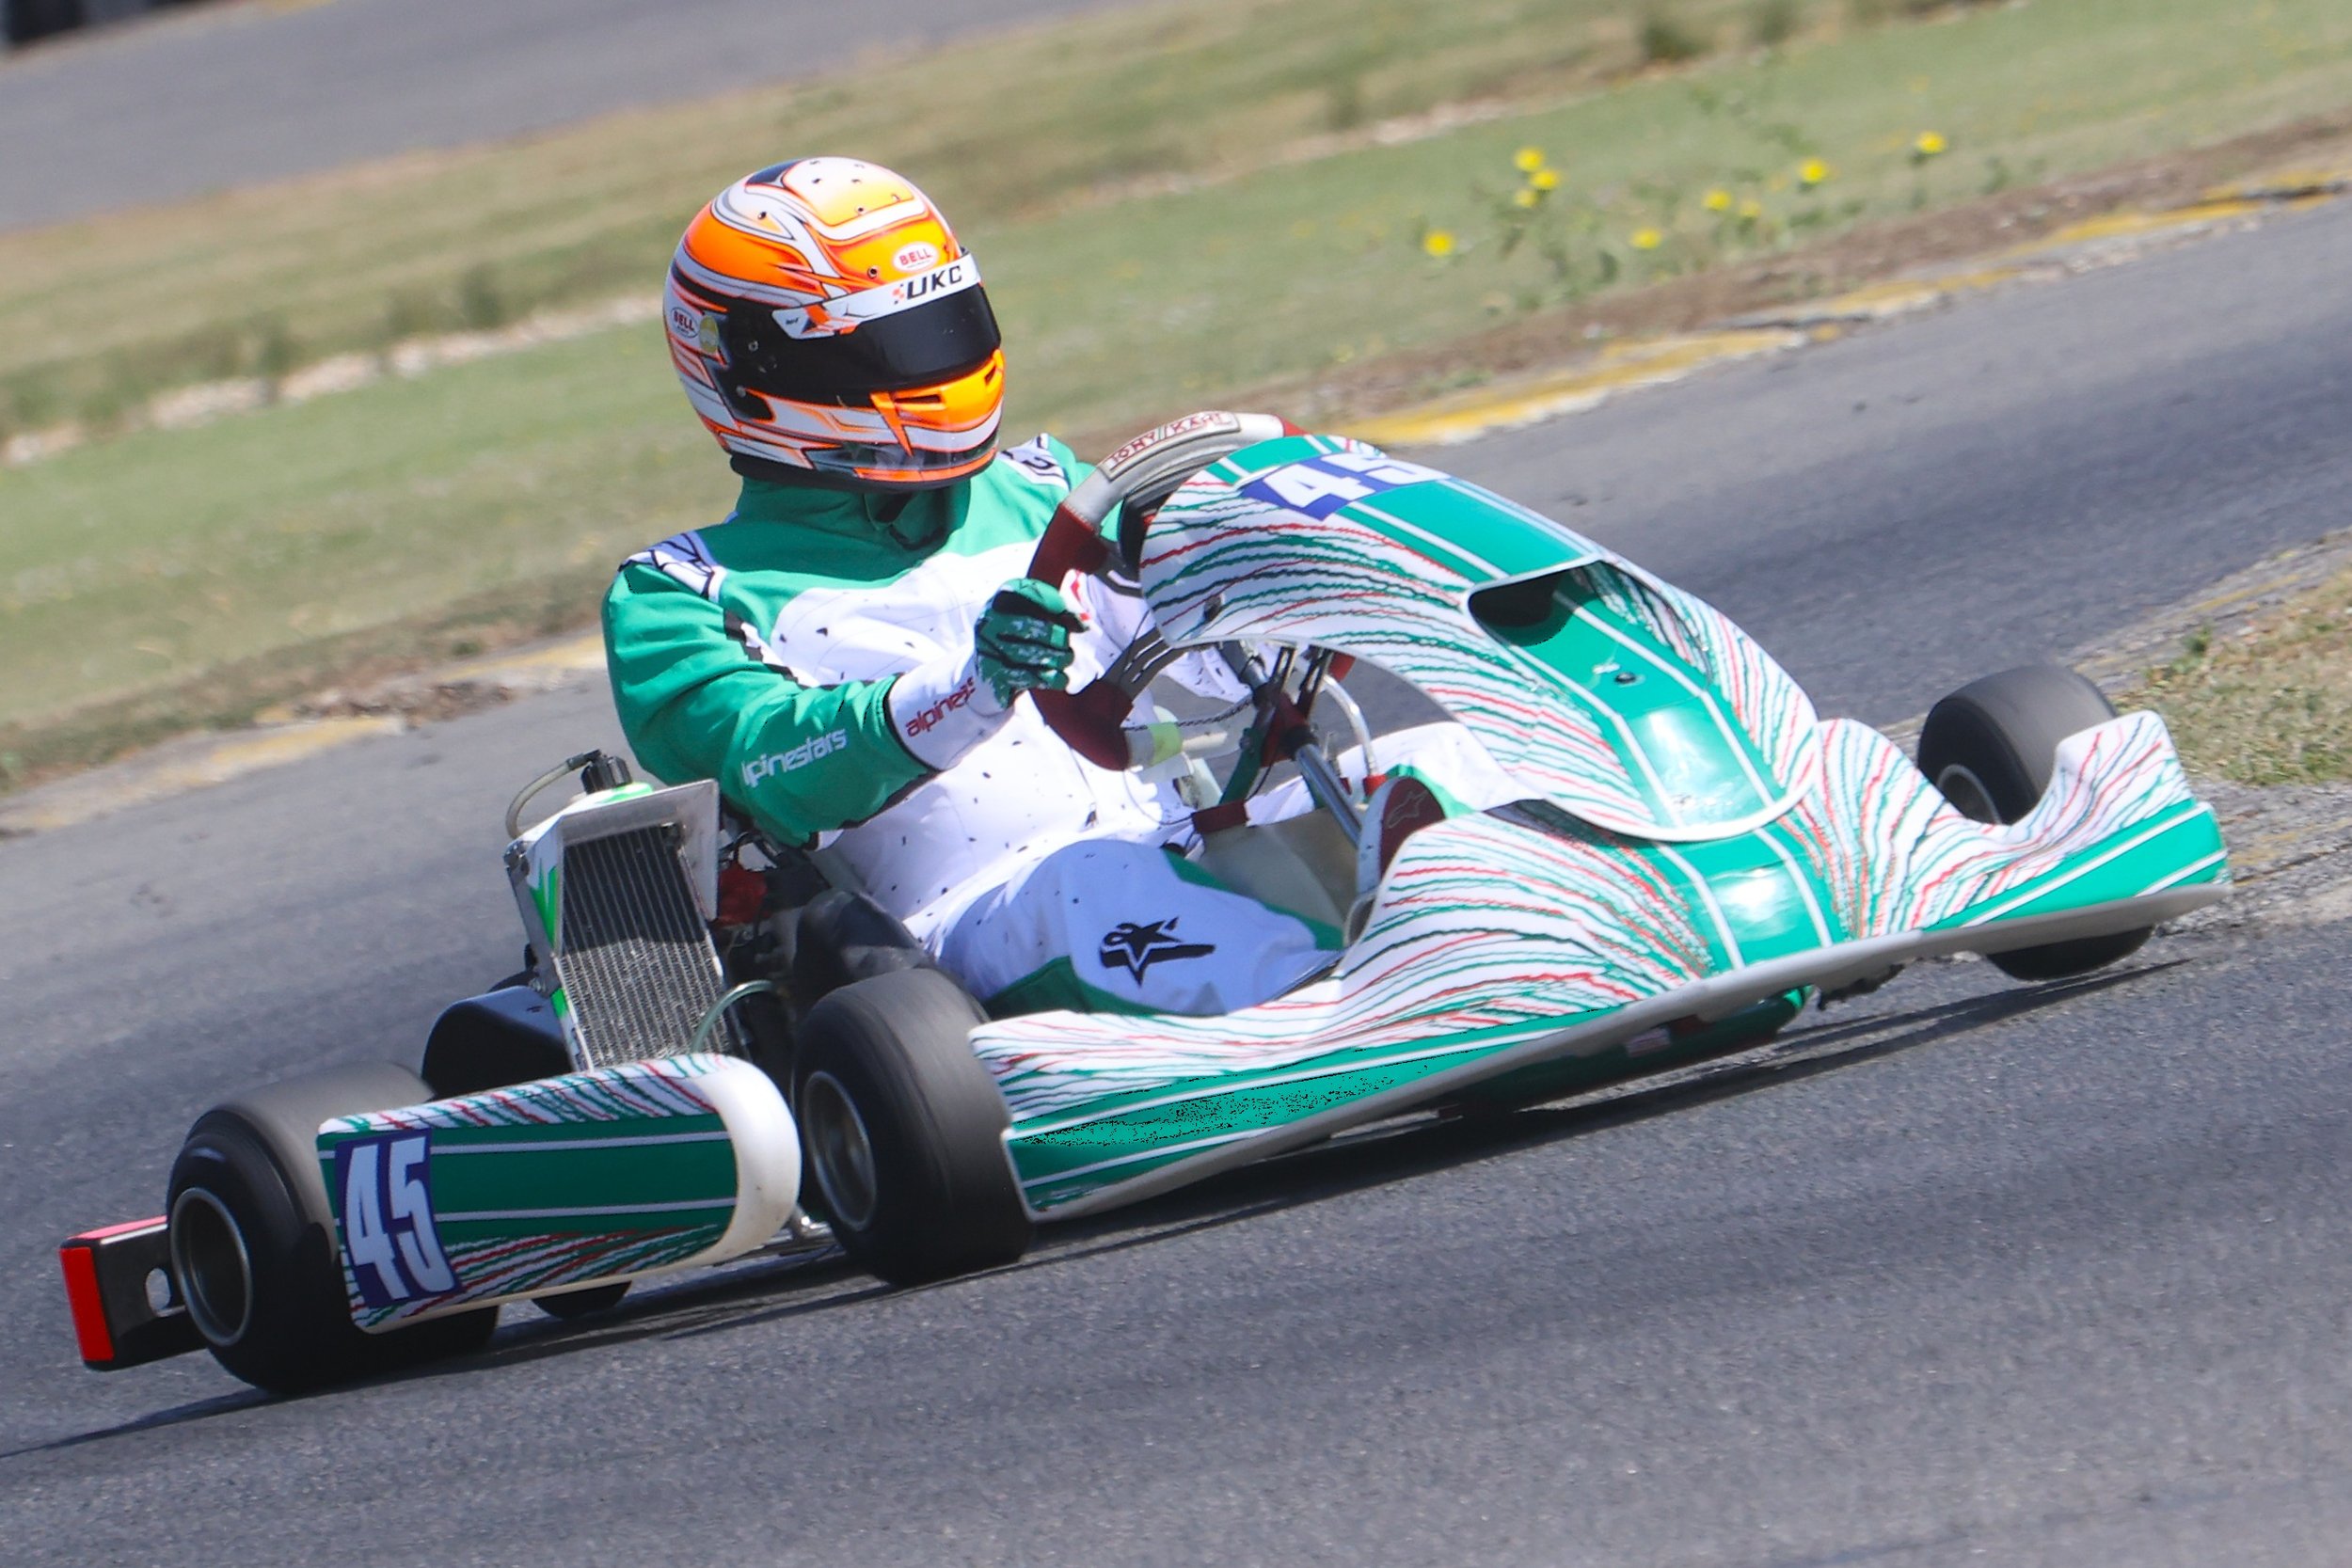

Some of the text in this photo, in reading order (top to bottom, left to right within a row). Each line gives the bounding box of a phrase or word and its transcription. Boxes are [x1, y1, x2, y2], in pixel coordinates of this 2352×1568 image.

[898, 248, 933, 266] BELL
[907, 265, 961, 299] UKC
[673, 310, 695, 332] BELL
[1263, 452, 1452, 508] 45
[741, 728, 847, 788] lpinestars
[345, 1135, 455, 1300] 45
